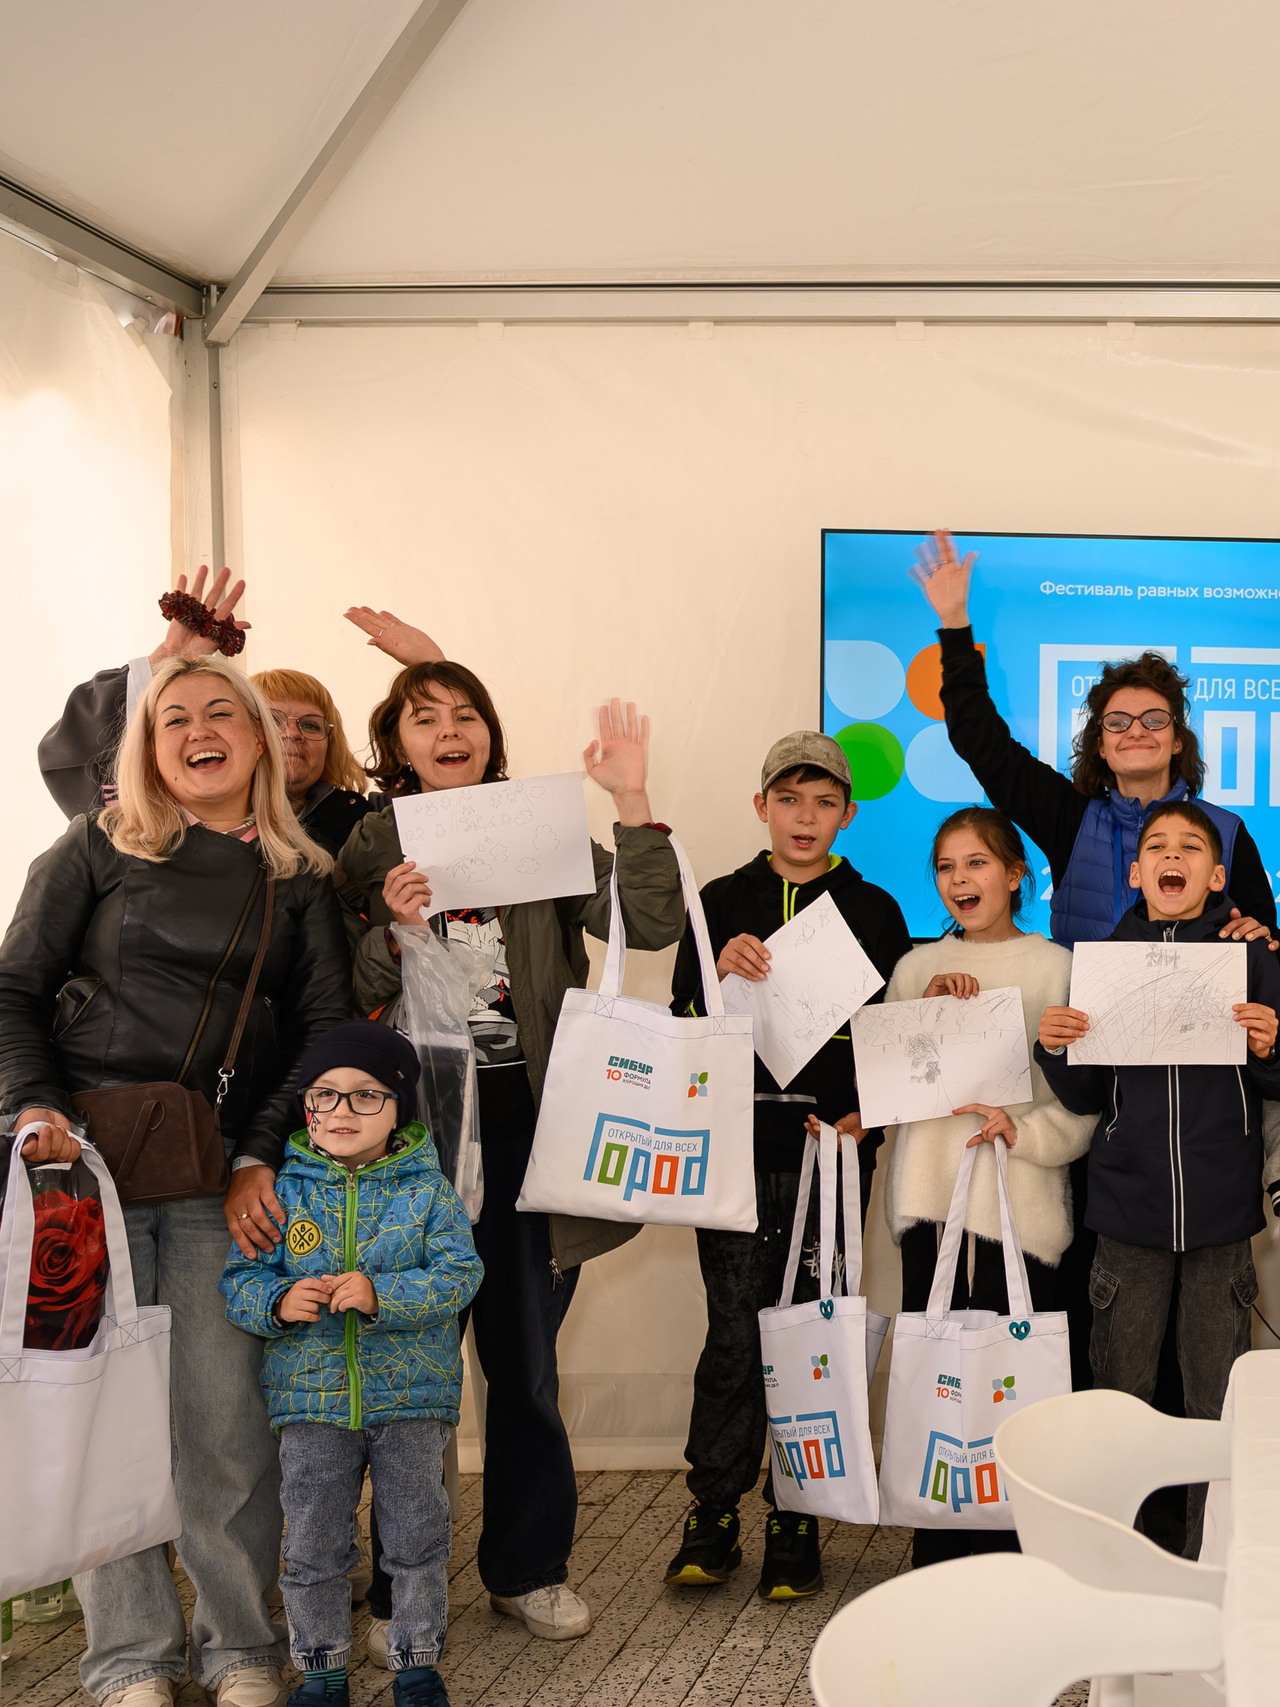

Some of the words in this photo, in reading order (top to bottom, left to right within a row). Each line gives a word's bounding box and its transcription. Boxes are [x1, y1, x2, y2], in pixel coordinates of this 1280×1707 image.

[1039, 581, 1133, 597] Фестиваль
[1137, 585, 1199, 600] равных
[1194, 678, 1236, 702] ДЛЯ
[608, 1055, 653, 1075] СИБУР
[606, 1069, 622, 1081] 10
[624, 1072, 651, 1085] ФОРМУЛА
[608, 1128, 652, 1147] ОТКРЫТЫЙ
[653, 1140, 672, 1151] ДЛЯ
[675, 1142, 698, 1152] ВСЕХ
[937, 1374, 961, 1390] СИБ
[936, 1387, 950, 1399] 10
[798, 1426, 812, 1438] ДЛЯ
[814, 1424, 831, 1435] ВСЕХ
[938, 1446, 968, 1463] ОТКРЫТЫЙ
[970, 1450, 987, 1464] ДЛЯ
[919, 1430, 1009, 1513] Горо
